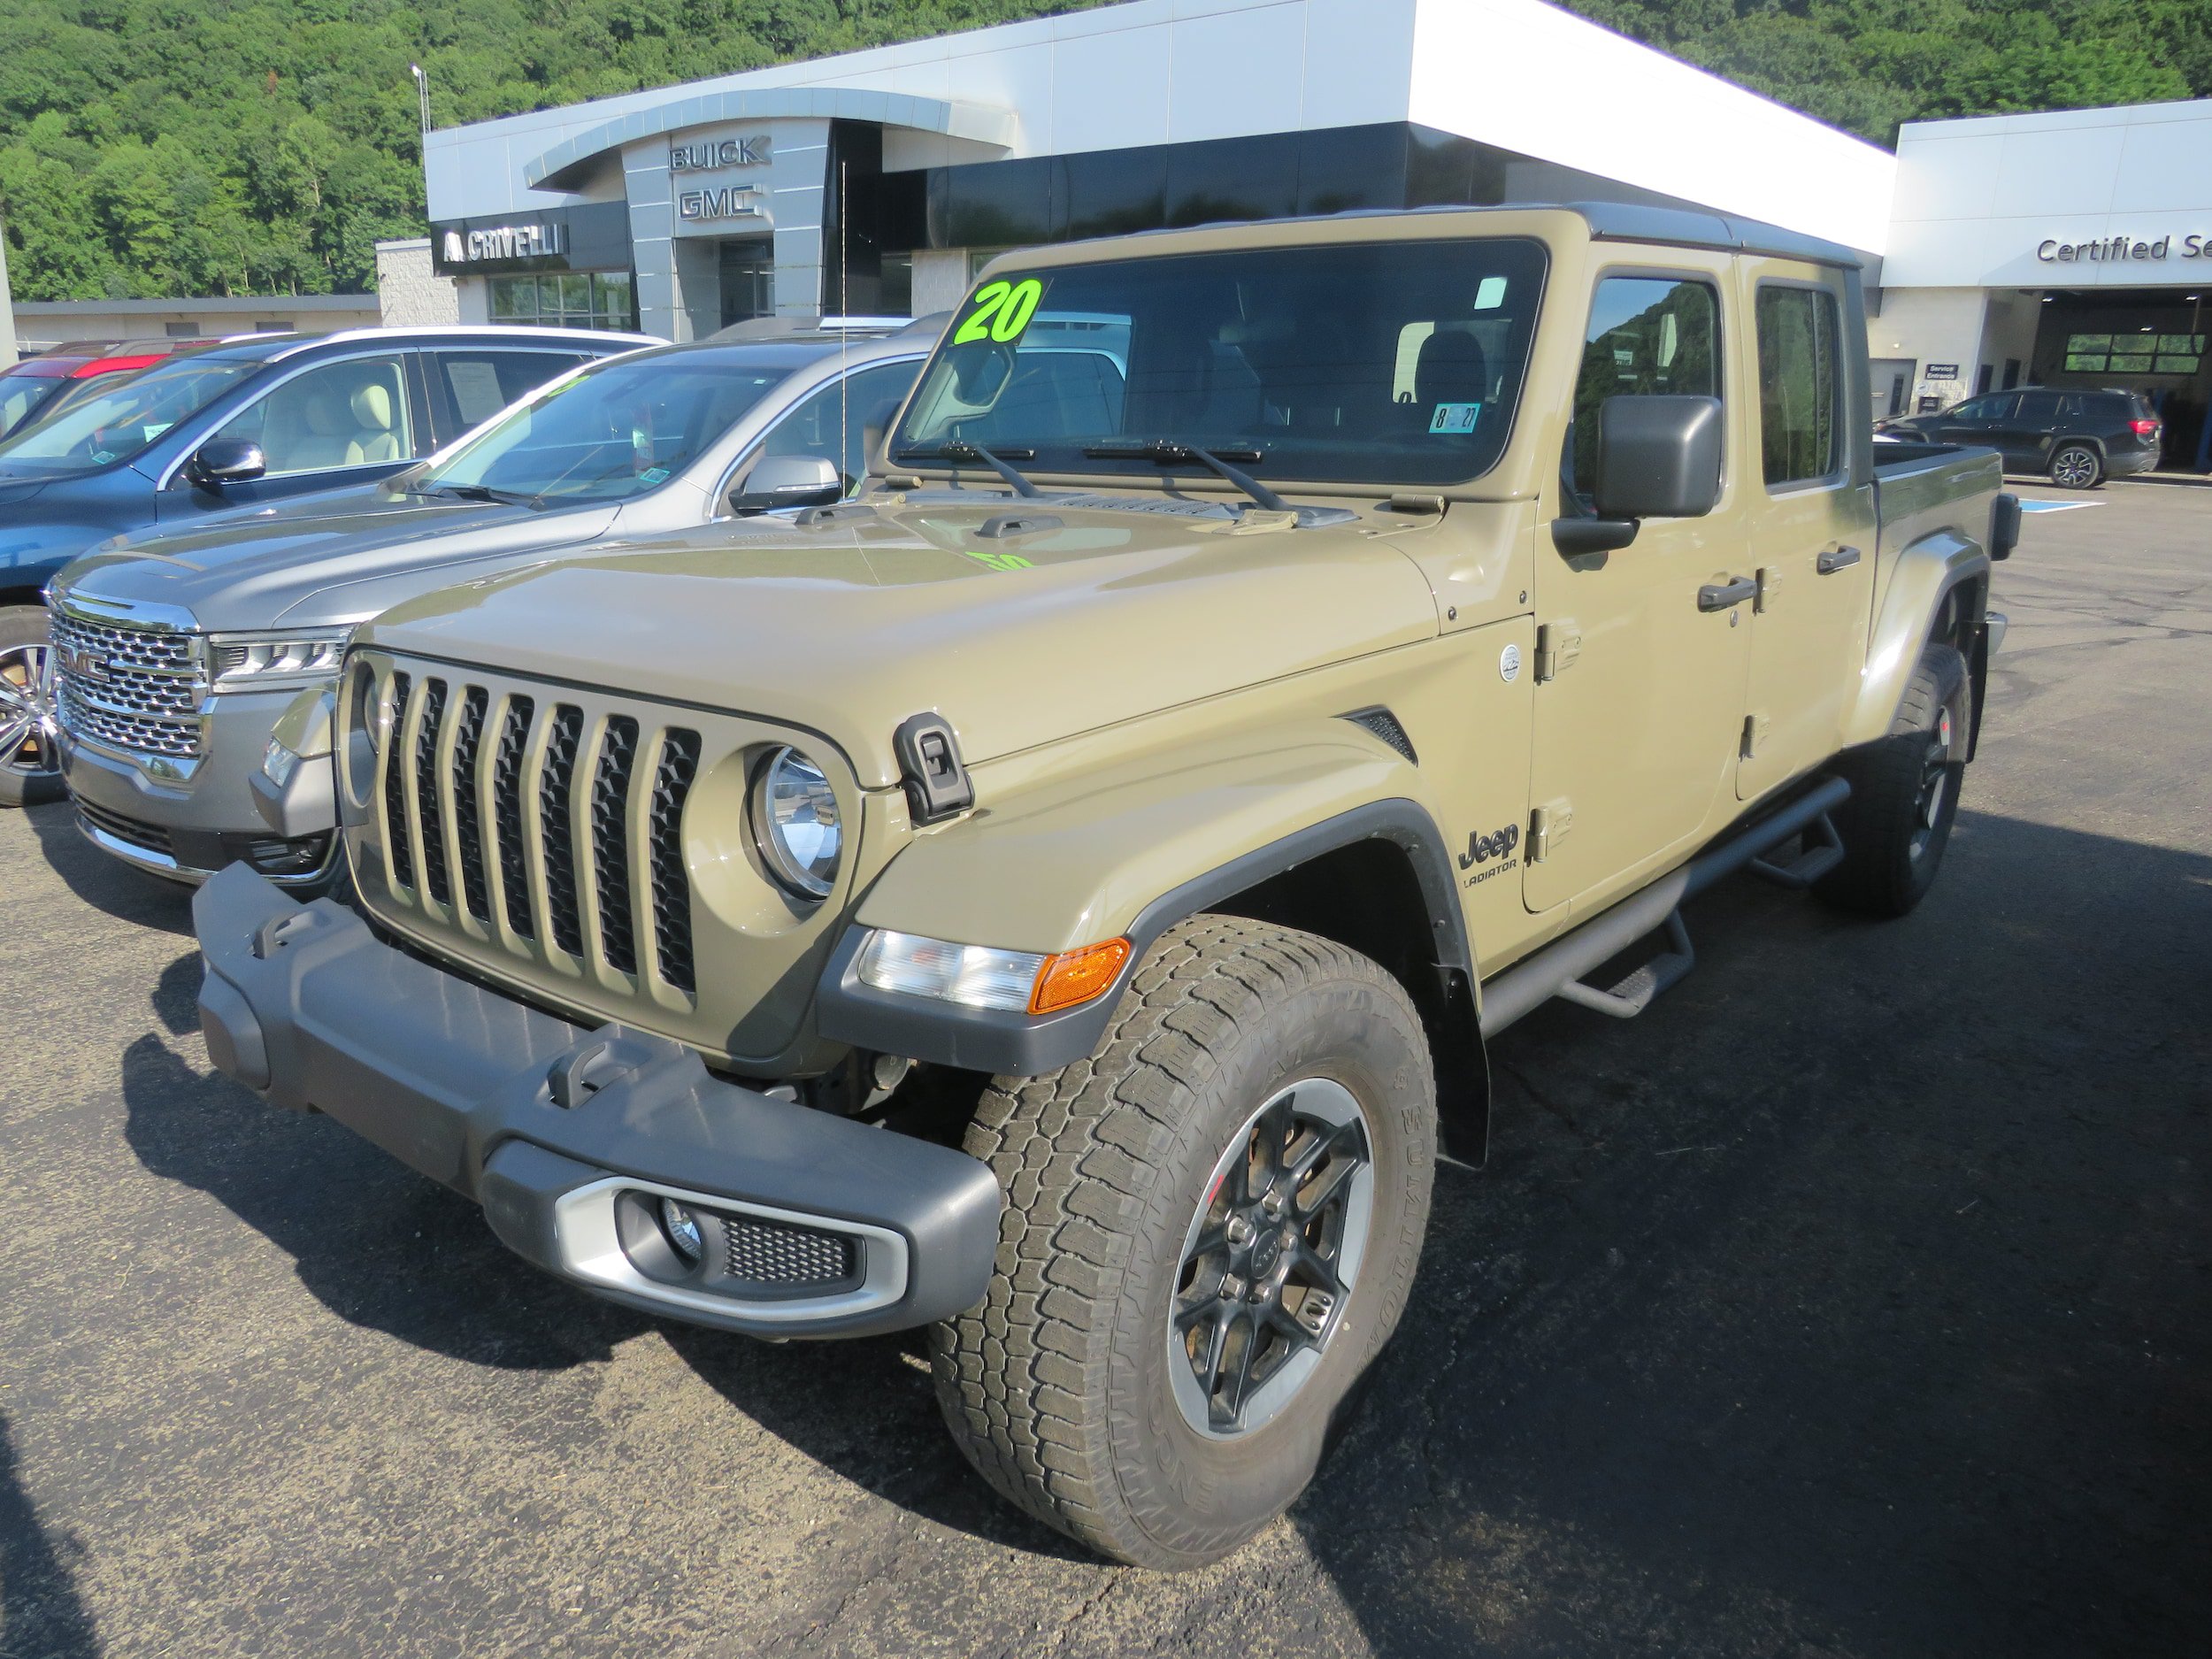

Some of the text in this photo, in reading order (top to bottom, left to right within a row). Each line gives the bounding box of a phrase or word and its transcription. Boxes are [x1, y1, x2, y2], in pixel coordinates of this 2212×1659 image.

[669, 139, 761, 172] BUICK
[678, 184, 763, 220] GMC
[468, 224, 559, 261] CRIVELLI
[2037, 234, 2170, 263] Certified
[953, 279, 1042, 346] 20
[1462, 407, 1477, 427] 27
[1458, 824, 1518, 871] Jeep
[1463, 859, 1517, 888] LADIATOR
[1356, 1104, 1423, 1371] SUMITOM
